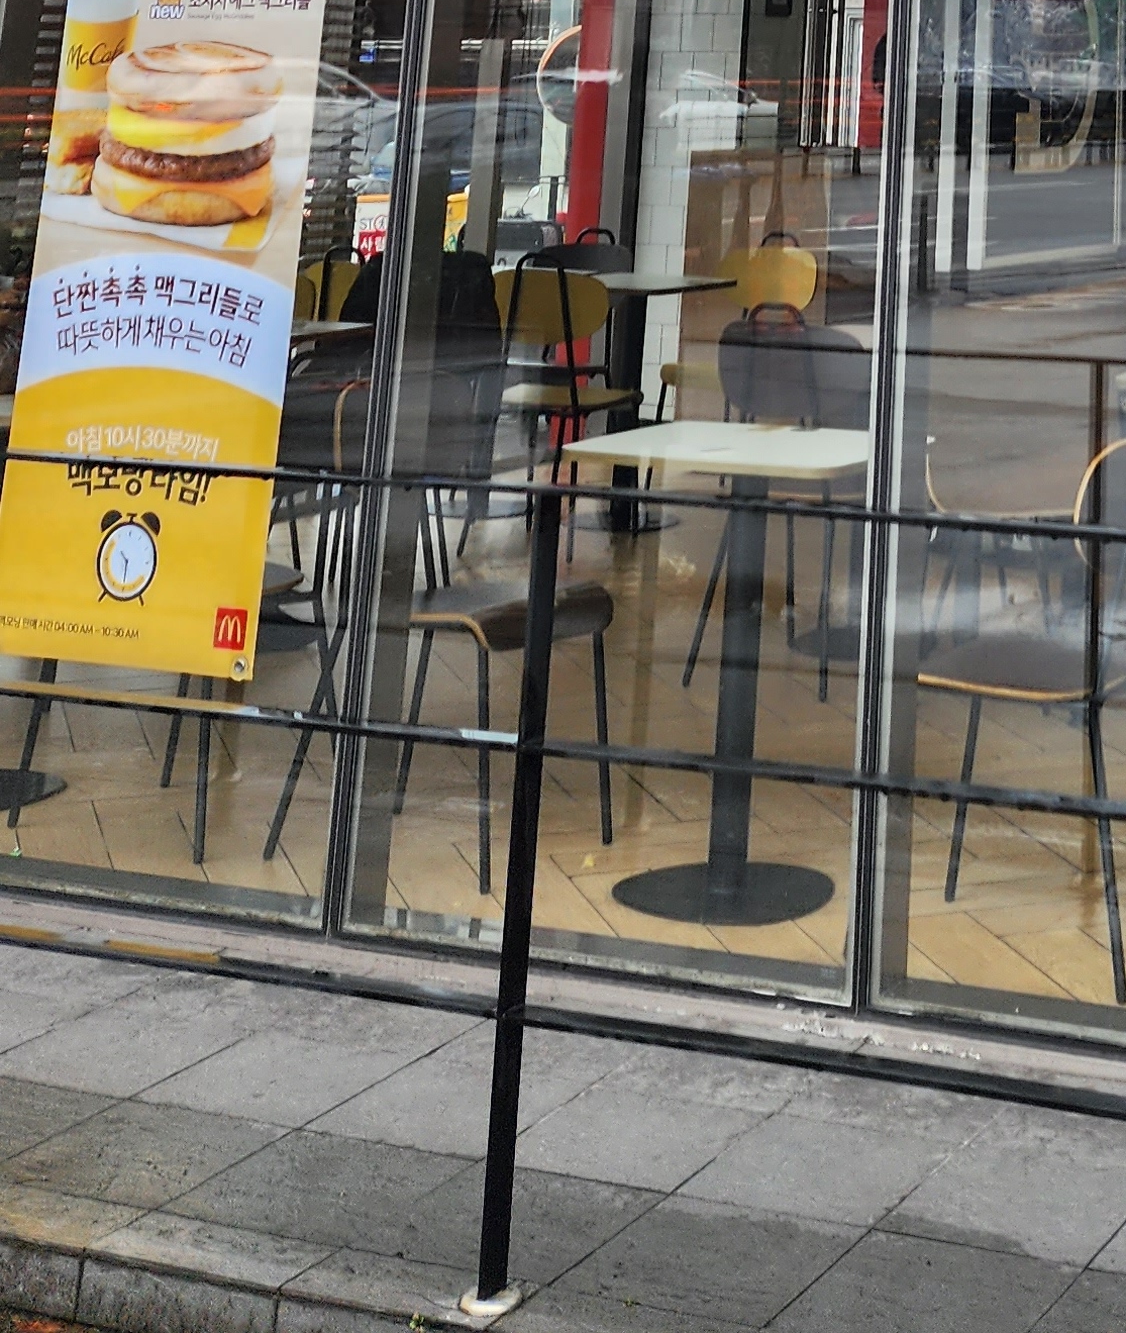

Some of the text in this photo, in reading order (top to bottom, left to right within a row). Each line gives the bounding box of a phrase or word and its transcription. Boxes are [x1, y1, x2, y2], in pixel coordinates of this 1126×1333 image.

[150, 4, 186, 20] new
[52, 273, 265, 326] 단짠촉촉 맥그리들로
[57, 315, 253, 369] 따뜻하게 채우는 아침
[66, 424, 220, 462] 아침 10시 30분까지
